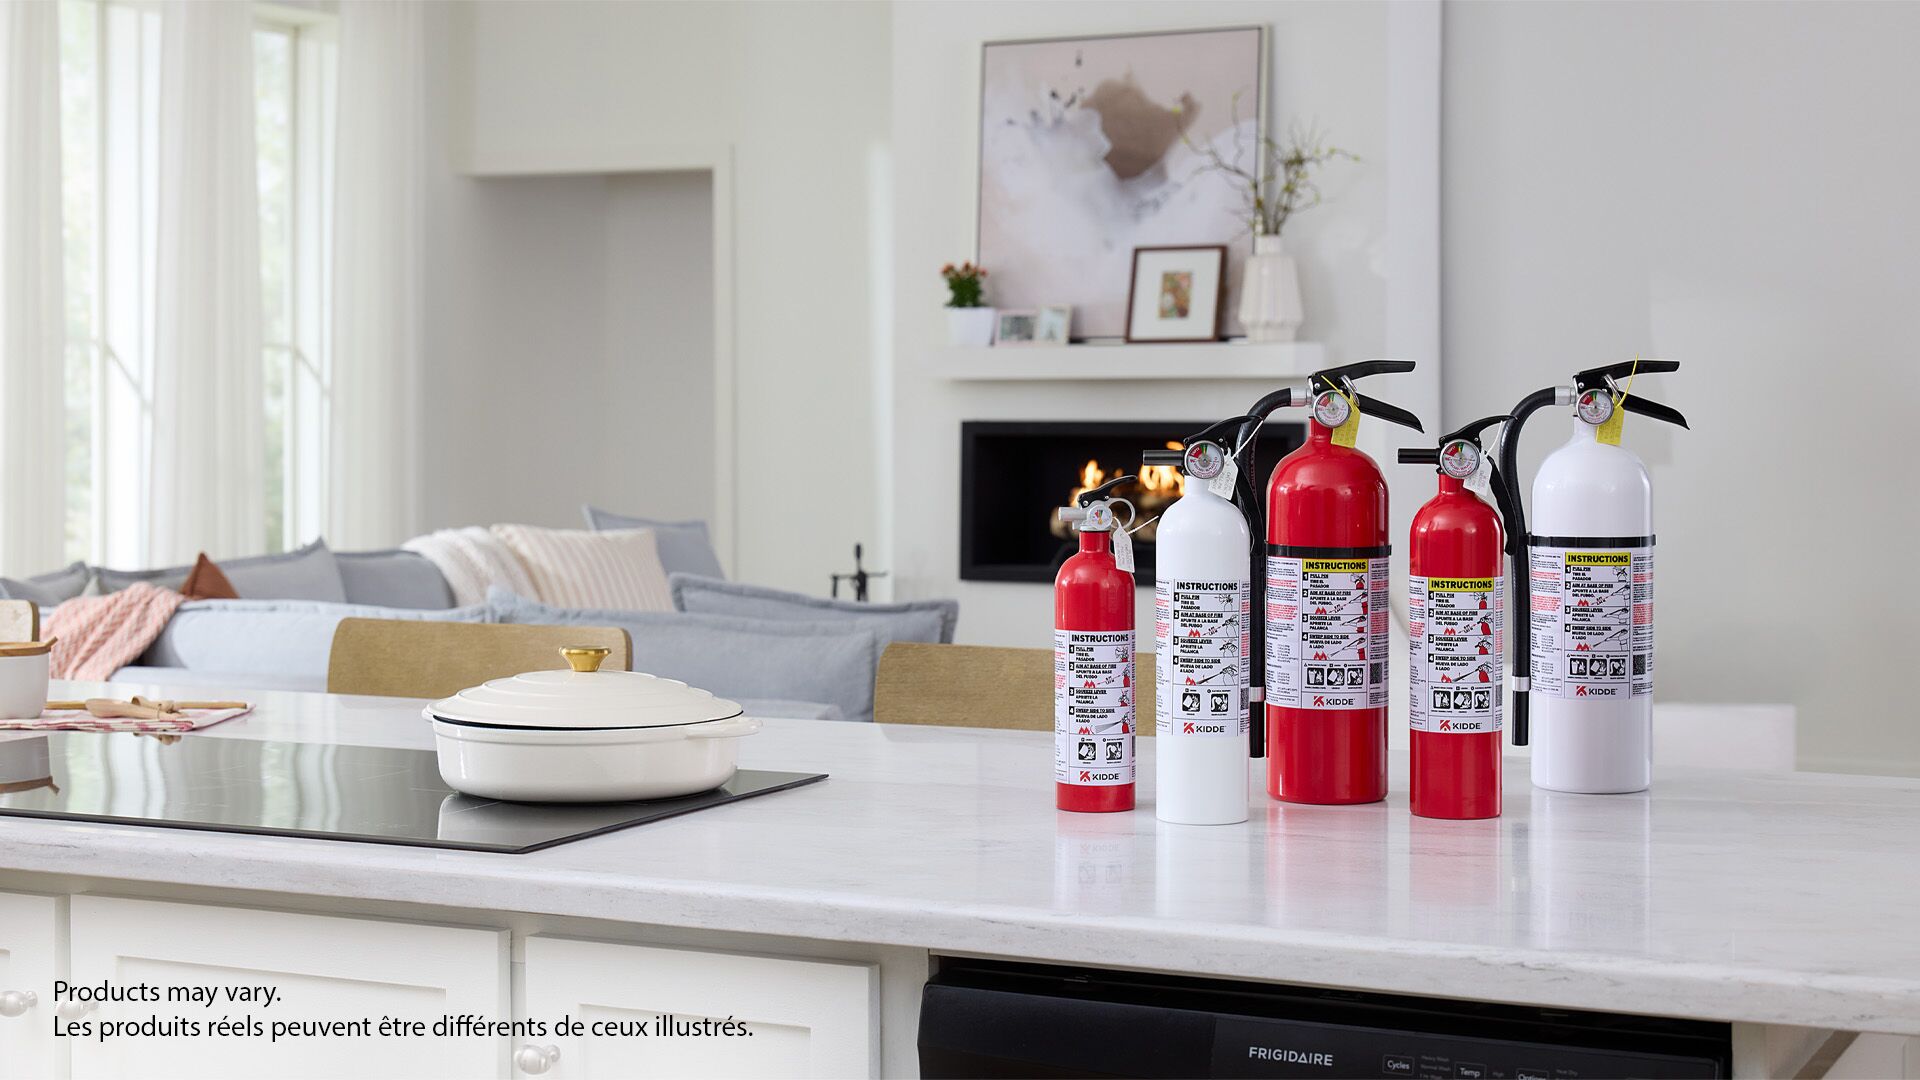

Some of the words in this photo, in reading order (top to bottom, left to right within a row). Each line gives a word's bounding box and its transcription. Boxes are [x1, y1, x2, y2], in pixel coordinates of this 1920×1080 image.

[1568, 555, 1628, 563] INSTRUCTIONS
[1306, 562, 1366, 570] INSTRUCTIONS
[1177, 582, 1238, 590] INSTRUCTIONS
[1432, 580, 1492, 589] INSTRUCTIONS
[1072, 634, 1128, 642] INSTRUCTIONS
[1249, 1046, 1333, 1066] FRIGIDAIRE
[1387, 1060, 1410, 1070] Cycles
[1460, 1067, 1480, 1078] Temp
